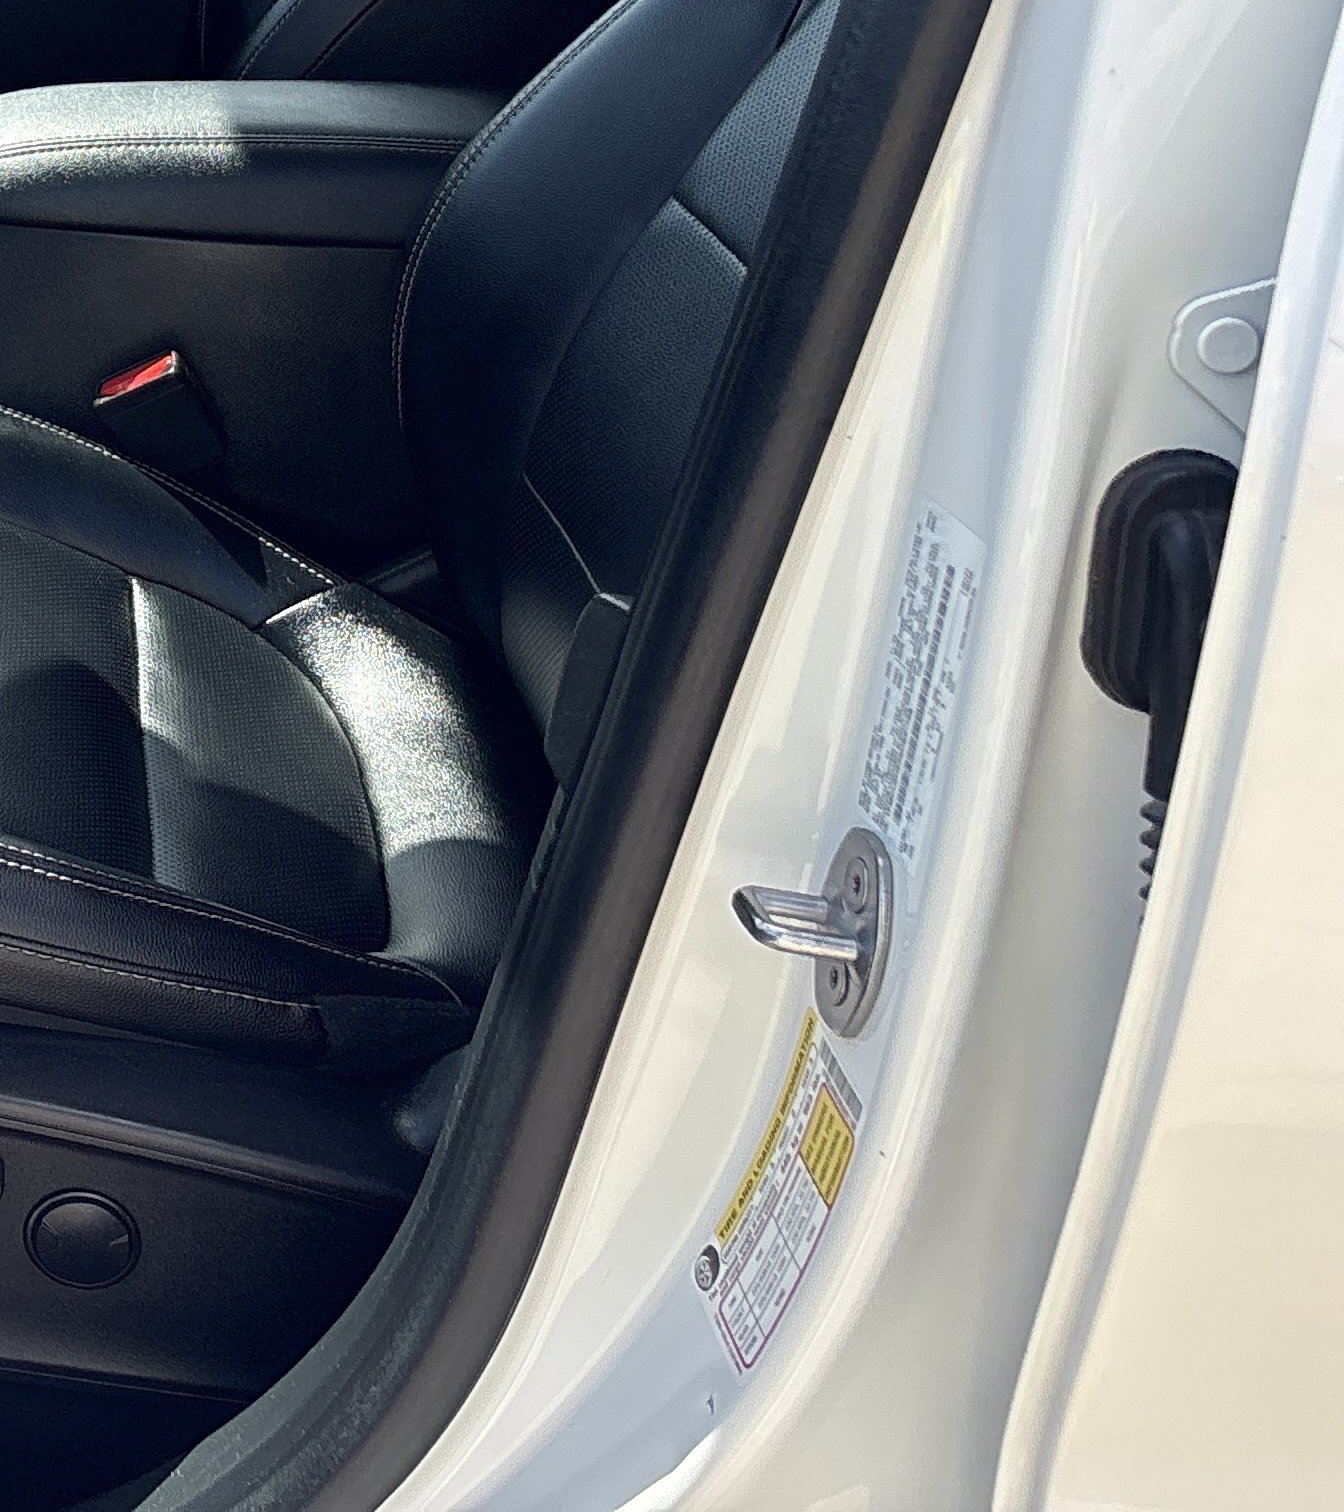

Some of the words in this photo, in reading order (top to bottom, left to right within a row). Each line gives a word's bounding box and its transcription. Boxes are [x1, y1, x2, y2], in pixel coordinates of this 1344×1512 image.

[718, 1206, 739, 1240] TIRE
[737, 1178, 754, 1209] AND
[752, 1117, 782, 1179] LOADING
[779, 1016, 815, 1116] INFORMATION
